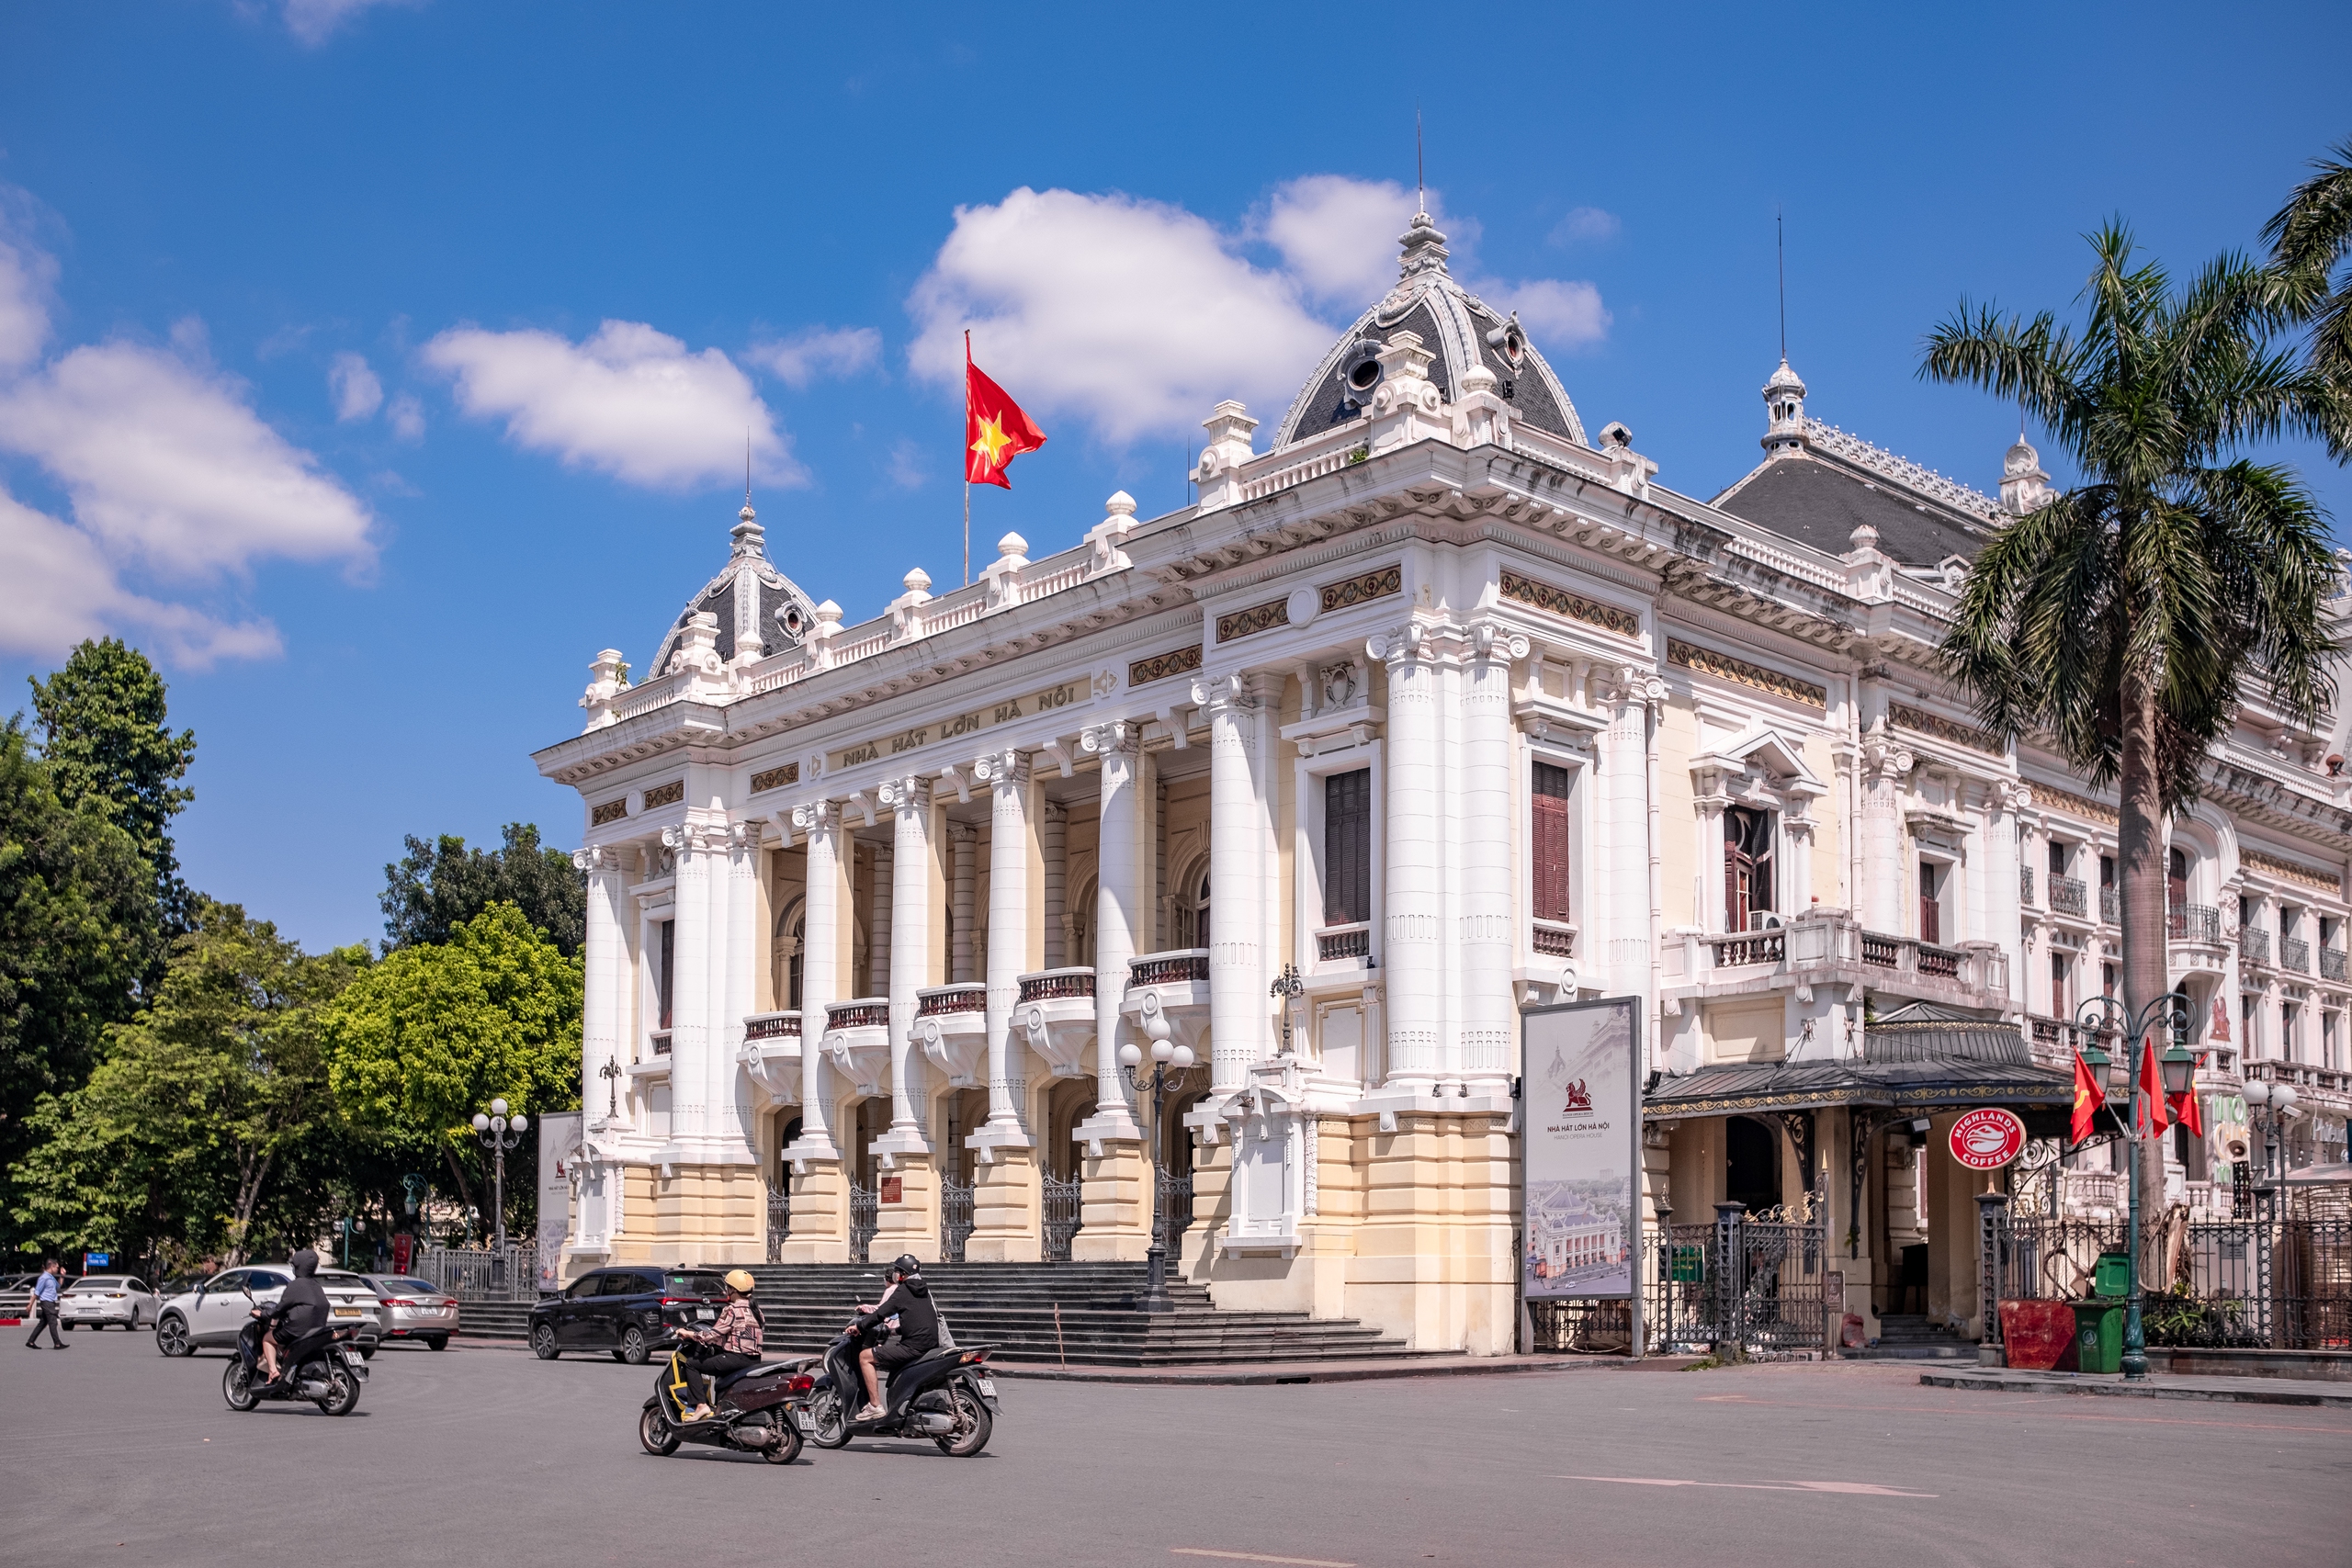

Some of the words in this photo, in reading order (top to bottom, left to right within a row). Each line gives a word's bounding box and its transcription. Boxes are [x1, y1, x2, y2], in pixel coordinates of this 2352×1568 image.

[842, 741, 879, 767] NHÀ
[891, 729, 927, 753] HÁT
[940, 715, 979, 739] LỚN
[994, 699, 1022, 723] HÀ
[1038, 685, 1074, 710] NỘI
[1547, 1123, 1560, 1133] NHÀ
[1561, 1123, 1573, 1132] HÁT
[1574, 1122, 1587, 1131] LỚN
[1588, 1122, 1597, 1131] HÀ
[1599, 1121, 1610, 1131] NỘI
[1954, 1111, 2016, 1138] HIGHLANDS
[1962, 1150, 2010, 1166] COFFEE
